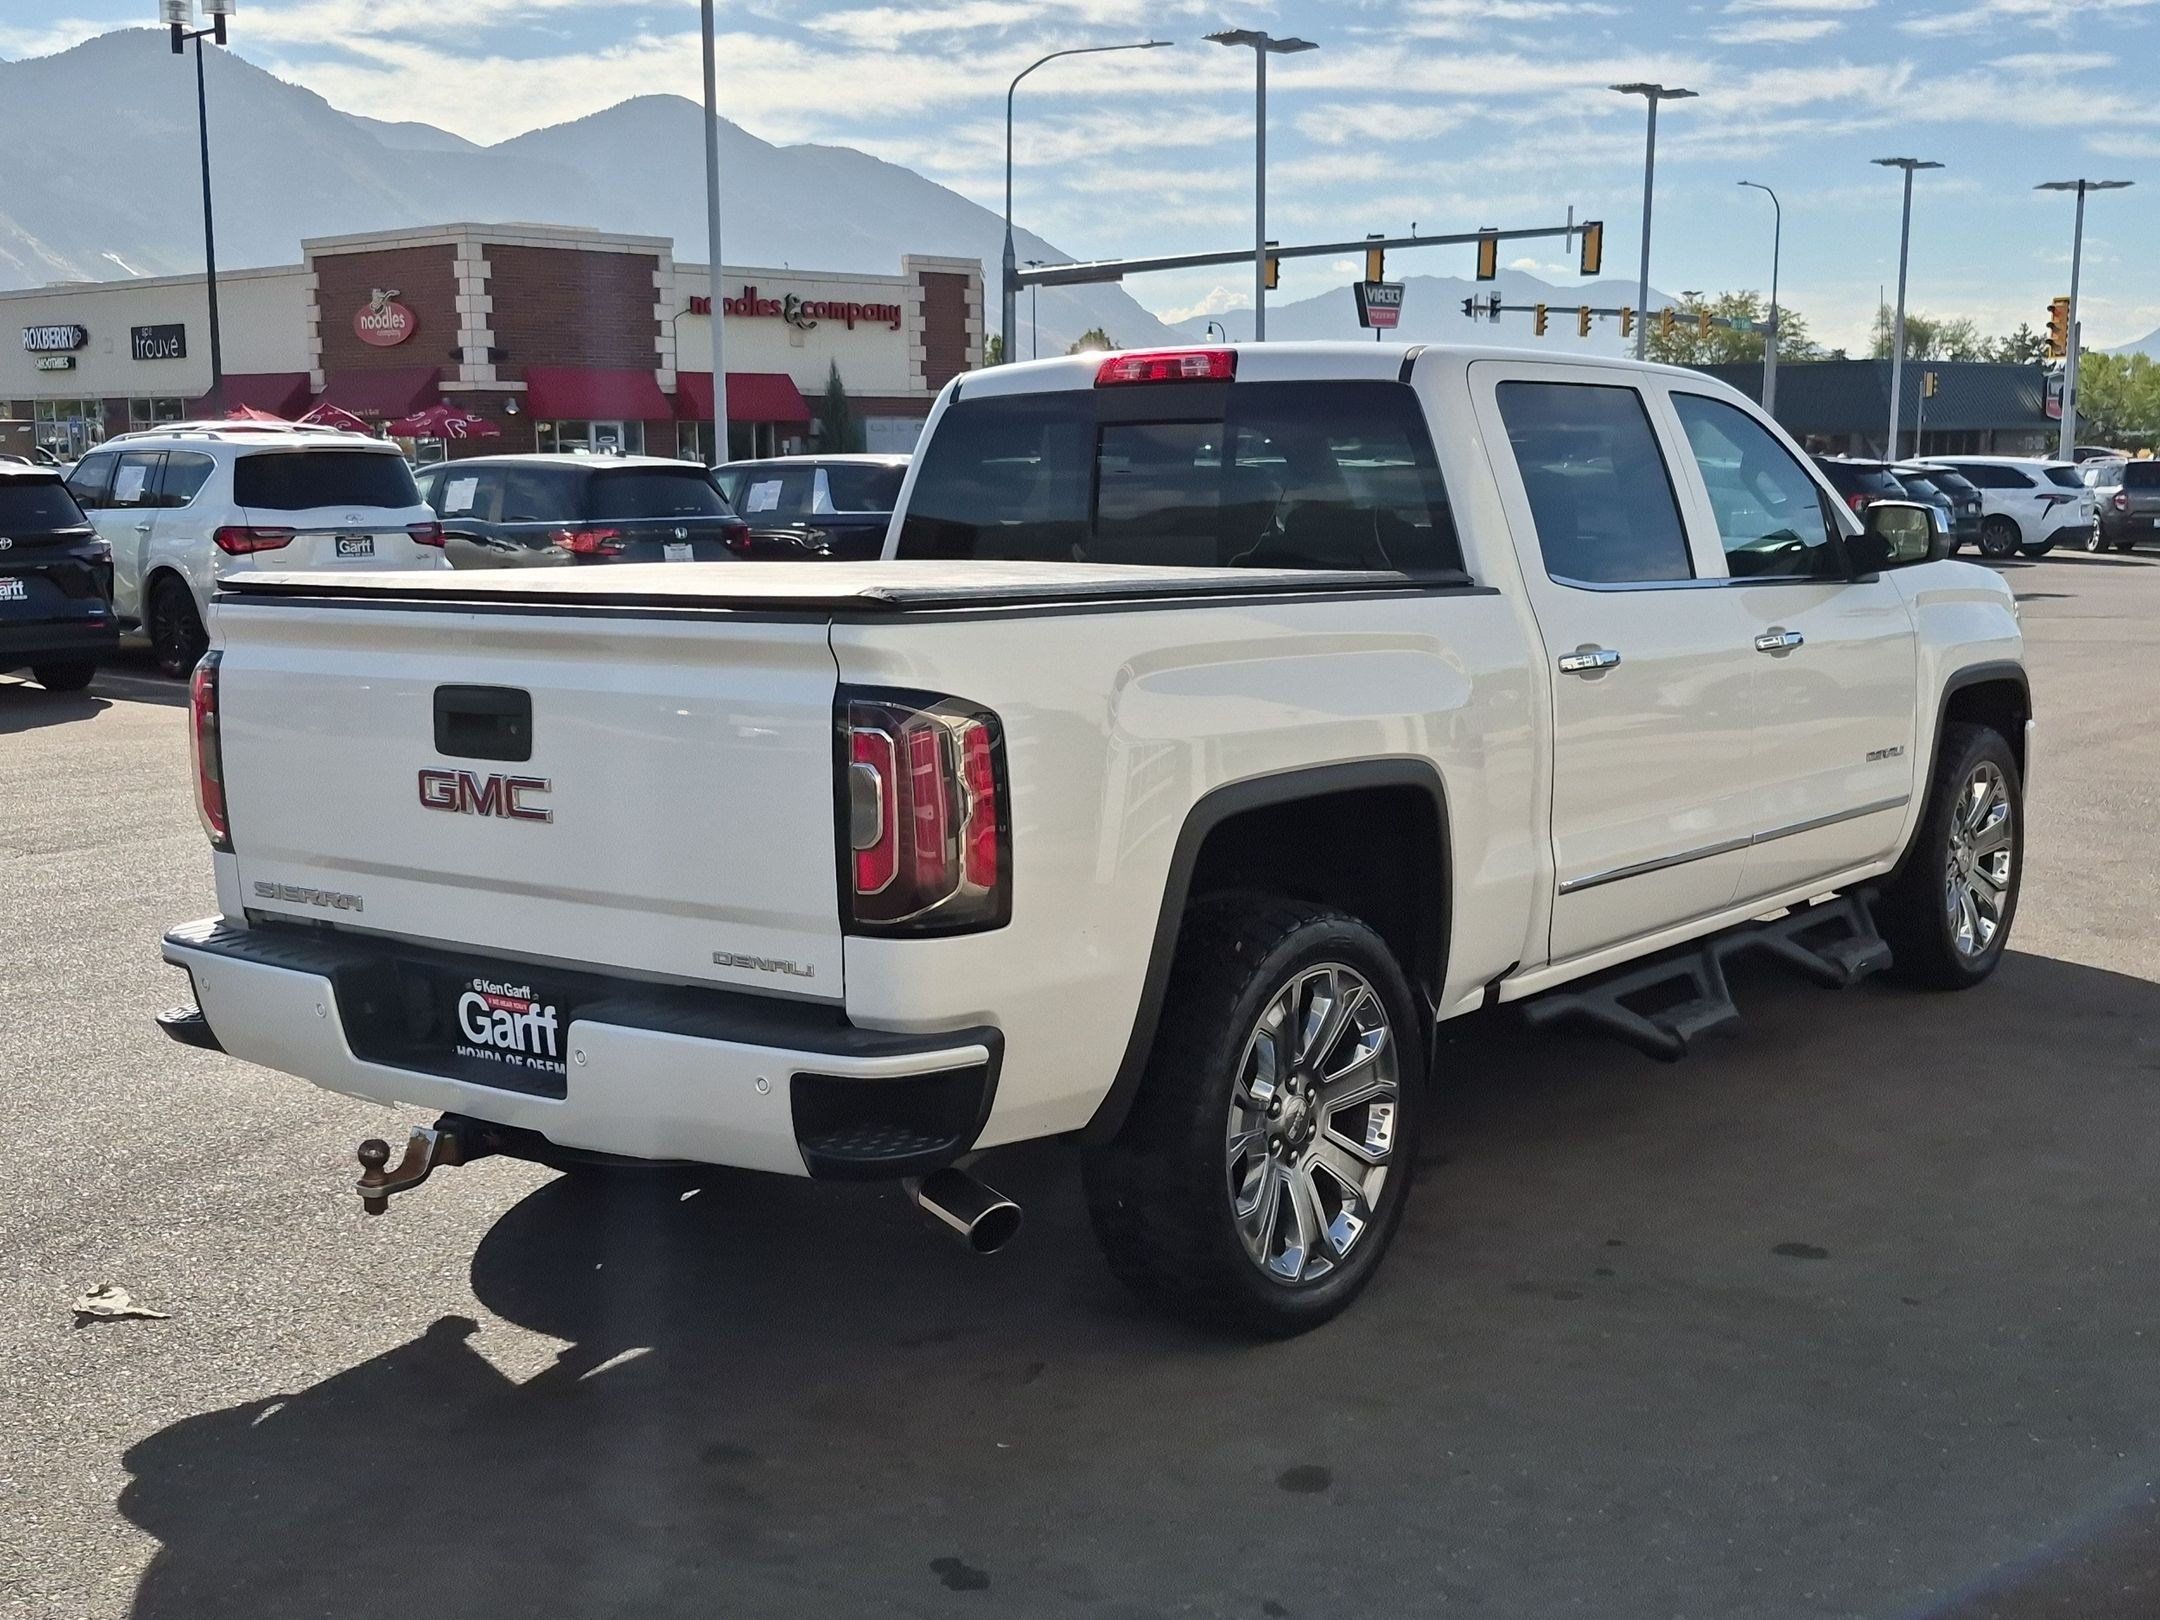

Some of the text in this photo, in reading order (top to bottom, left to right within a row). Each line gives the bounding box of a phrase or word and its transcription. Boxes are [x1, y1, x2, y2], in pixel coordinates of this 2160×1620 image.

[361, 306, 405, 329] noodles
[801, 301, 901, 330] company
[23, 326, 74, 349] ROXBERRY
[135, 335, 179, 358] trouvé
[339, 539, 371, 553] Garff
[0, 580, 24, 596] arff
[418, 766, 553, 824] GMC
[254, 881, 363, 912] SIERRA
[712, 951, 815, 977] DENALI
[482, 980, 531, 999] Ken Garff
[458, 991, 558, 1057] Garff
